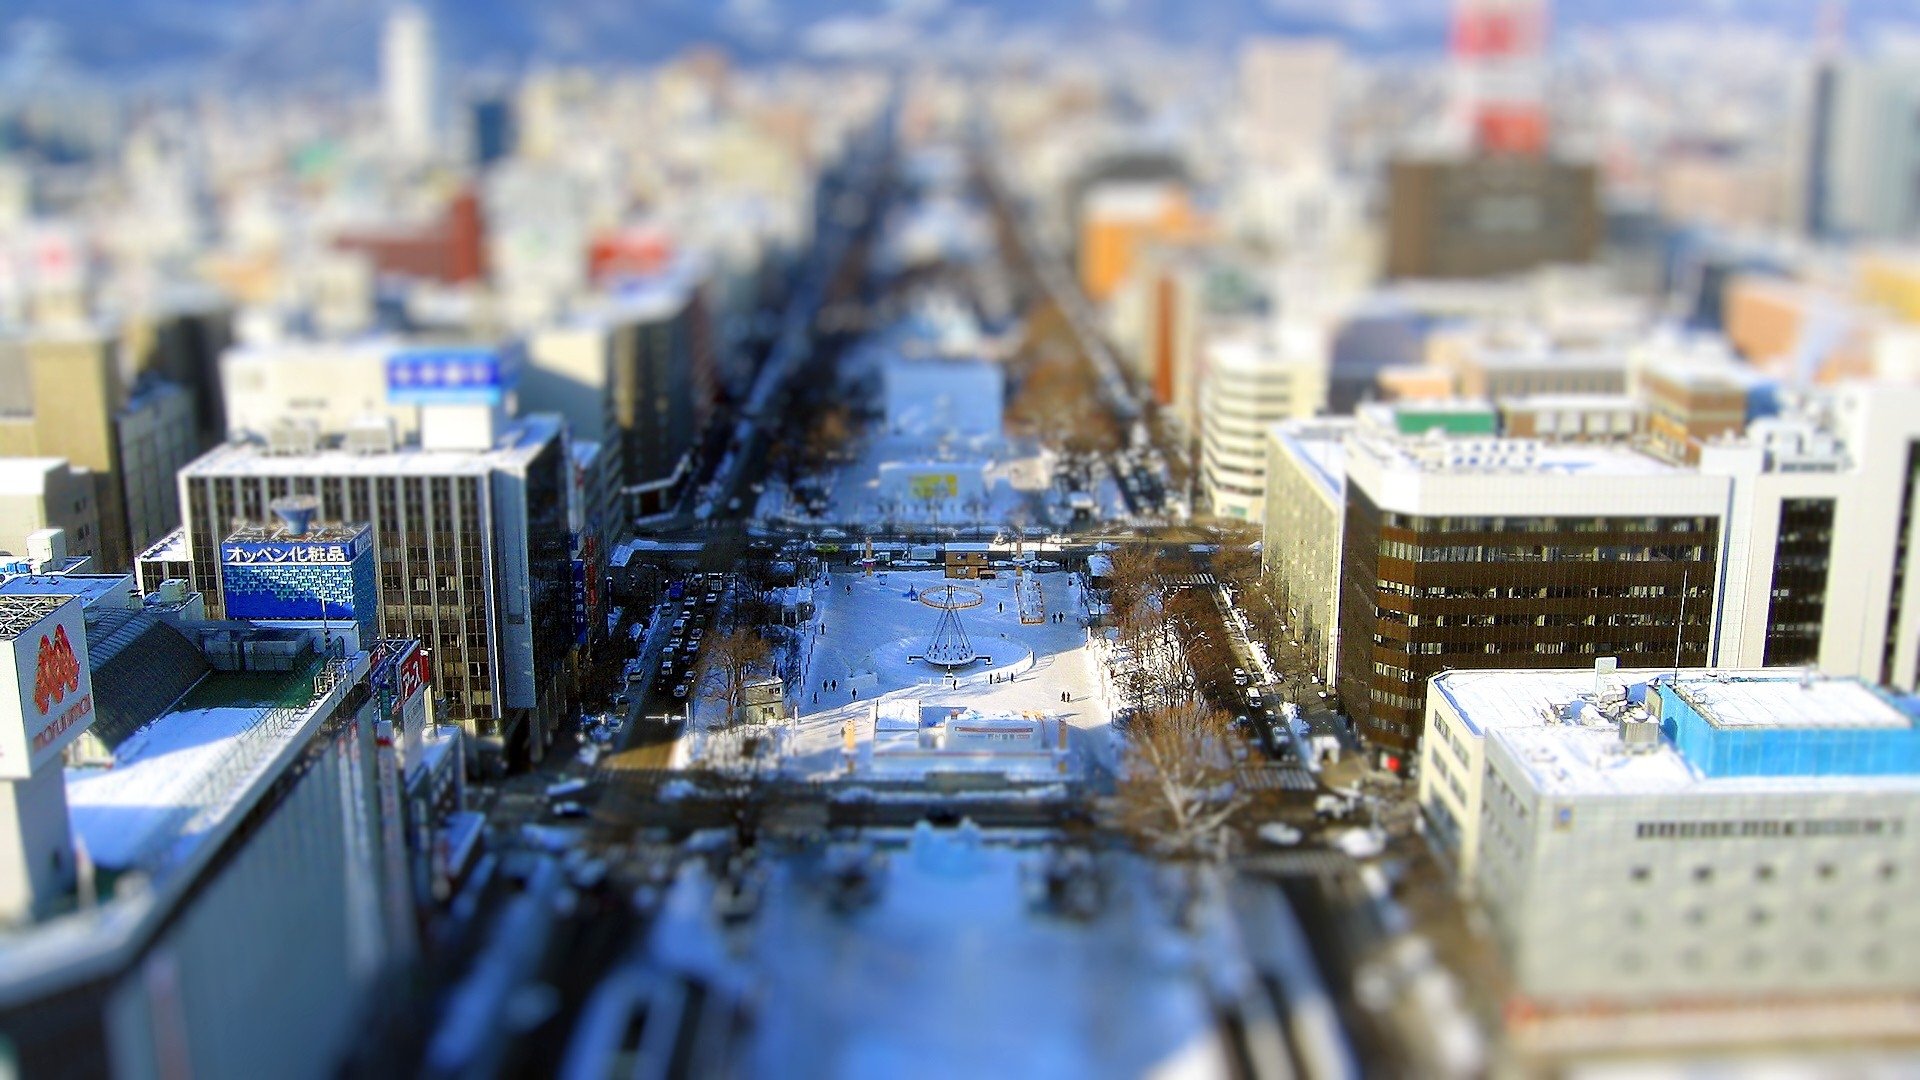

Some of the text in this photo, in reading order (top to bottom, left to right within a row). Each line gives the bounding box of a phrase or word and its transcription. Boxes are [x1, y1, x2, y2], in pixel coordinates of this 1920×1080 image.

[226, 545, 346, 563] オッペン化粧品
